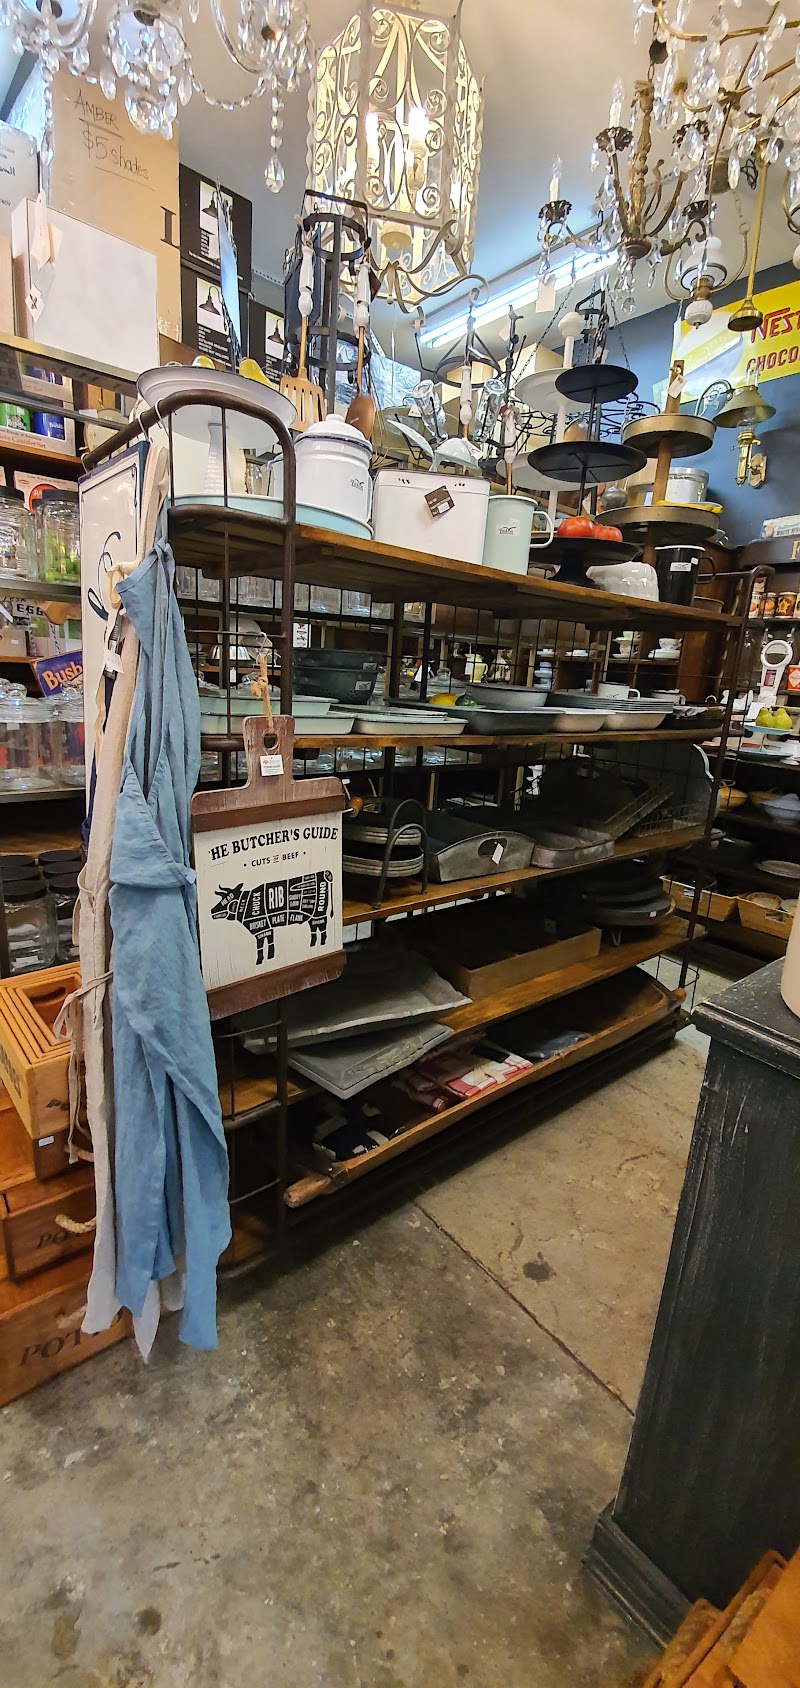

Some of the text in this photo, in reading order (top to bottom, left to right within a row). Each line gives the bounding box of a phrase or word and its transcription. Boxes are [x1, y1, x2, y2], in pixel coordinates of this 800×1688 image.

[74, 88, 119, 131] AMBER
[82, 123, 149, 179] $5 shades
[746, 346, 799, 375] CHOCO
[209, 826, 339, 861] HE BUTCHER'S GUIDE
[251, 856, 271, 867] CUTS
[282, 851, 299, 861] BEEF
[251, 891, 261, 916] CHUCK
[268, 886, 285, 910] RIB
[317, 881, 327, 912] ROUND
[271, 913, 286, 925] PLATE
[289, 913, 304, 922] FLANK
